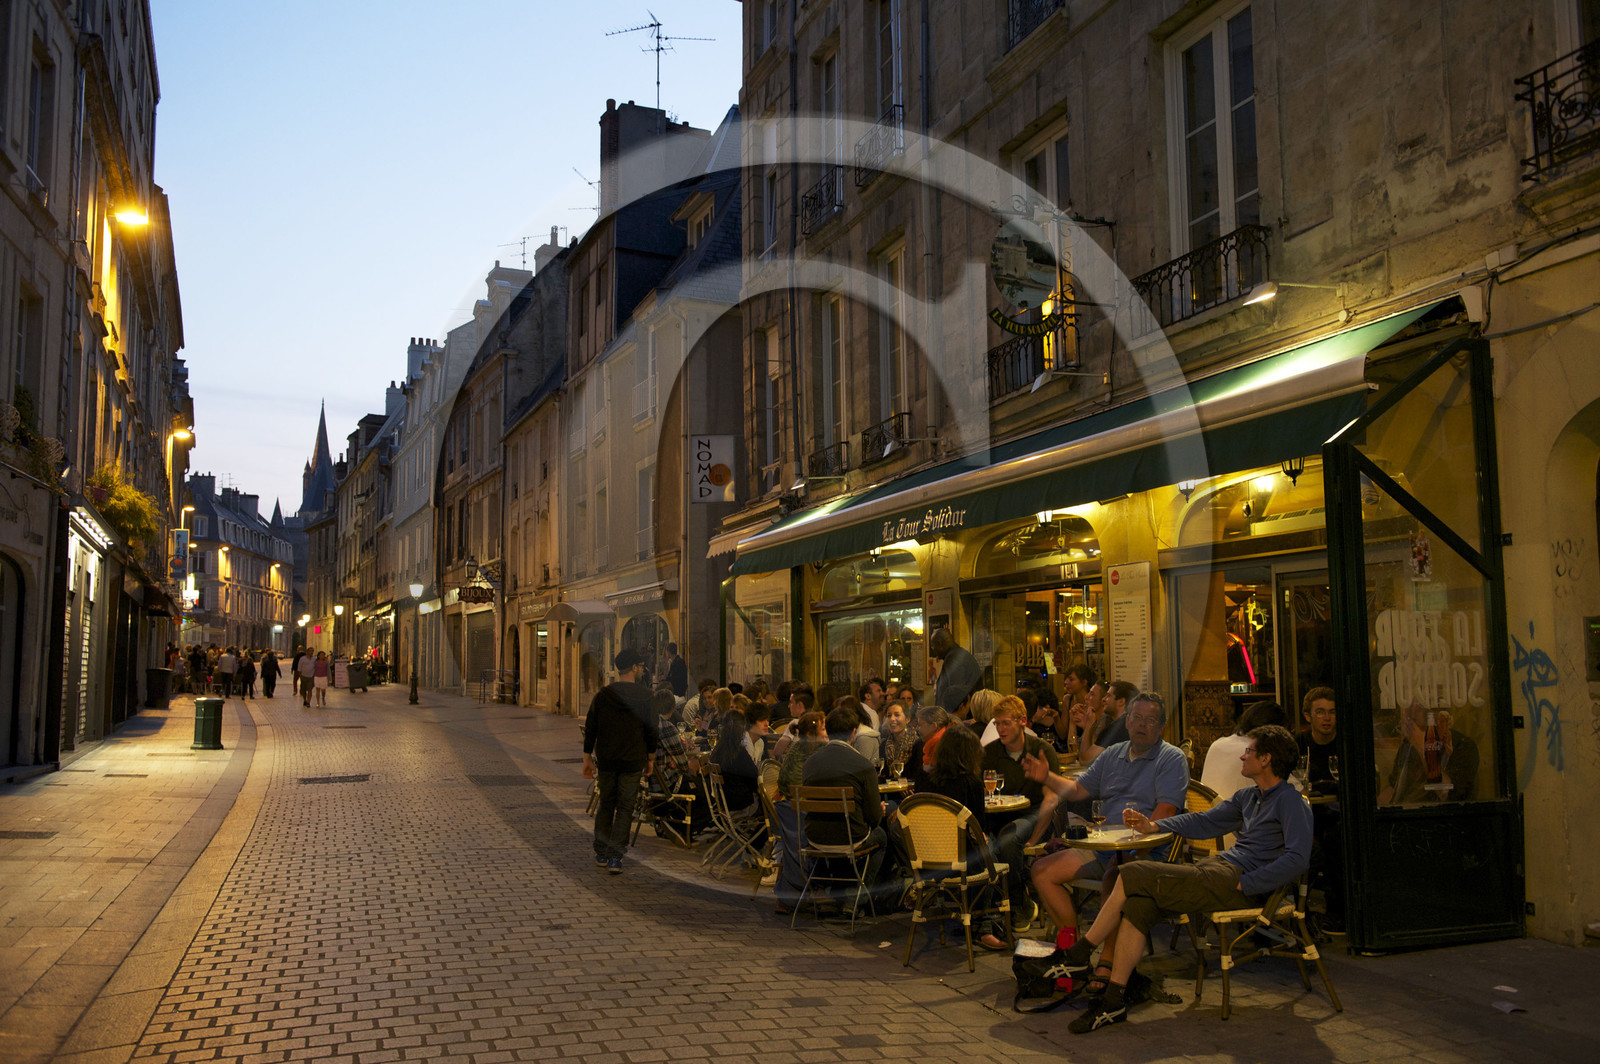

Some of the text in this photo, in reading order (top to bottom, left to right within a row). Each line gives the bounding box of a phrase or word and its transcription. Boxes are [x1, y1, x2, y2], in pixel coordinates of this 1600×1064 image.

[992, 310, 1004, 325] LA
[696, 439, 713, 498] NOMAD
[882, 505, 967, 543] La Tour Solidor
[461, 588, 492, 597] BIJOUX
